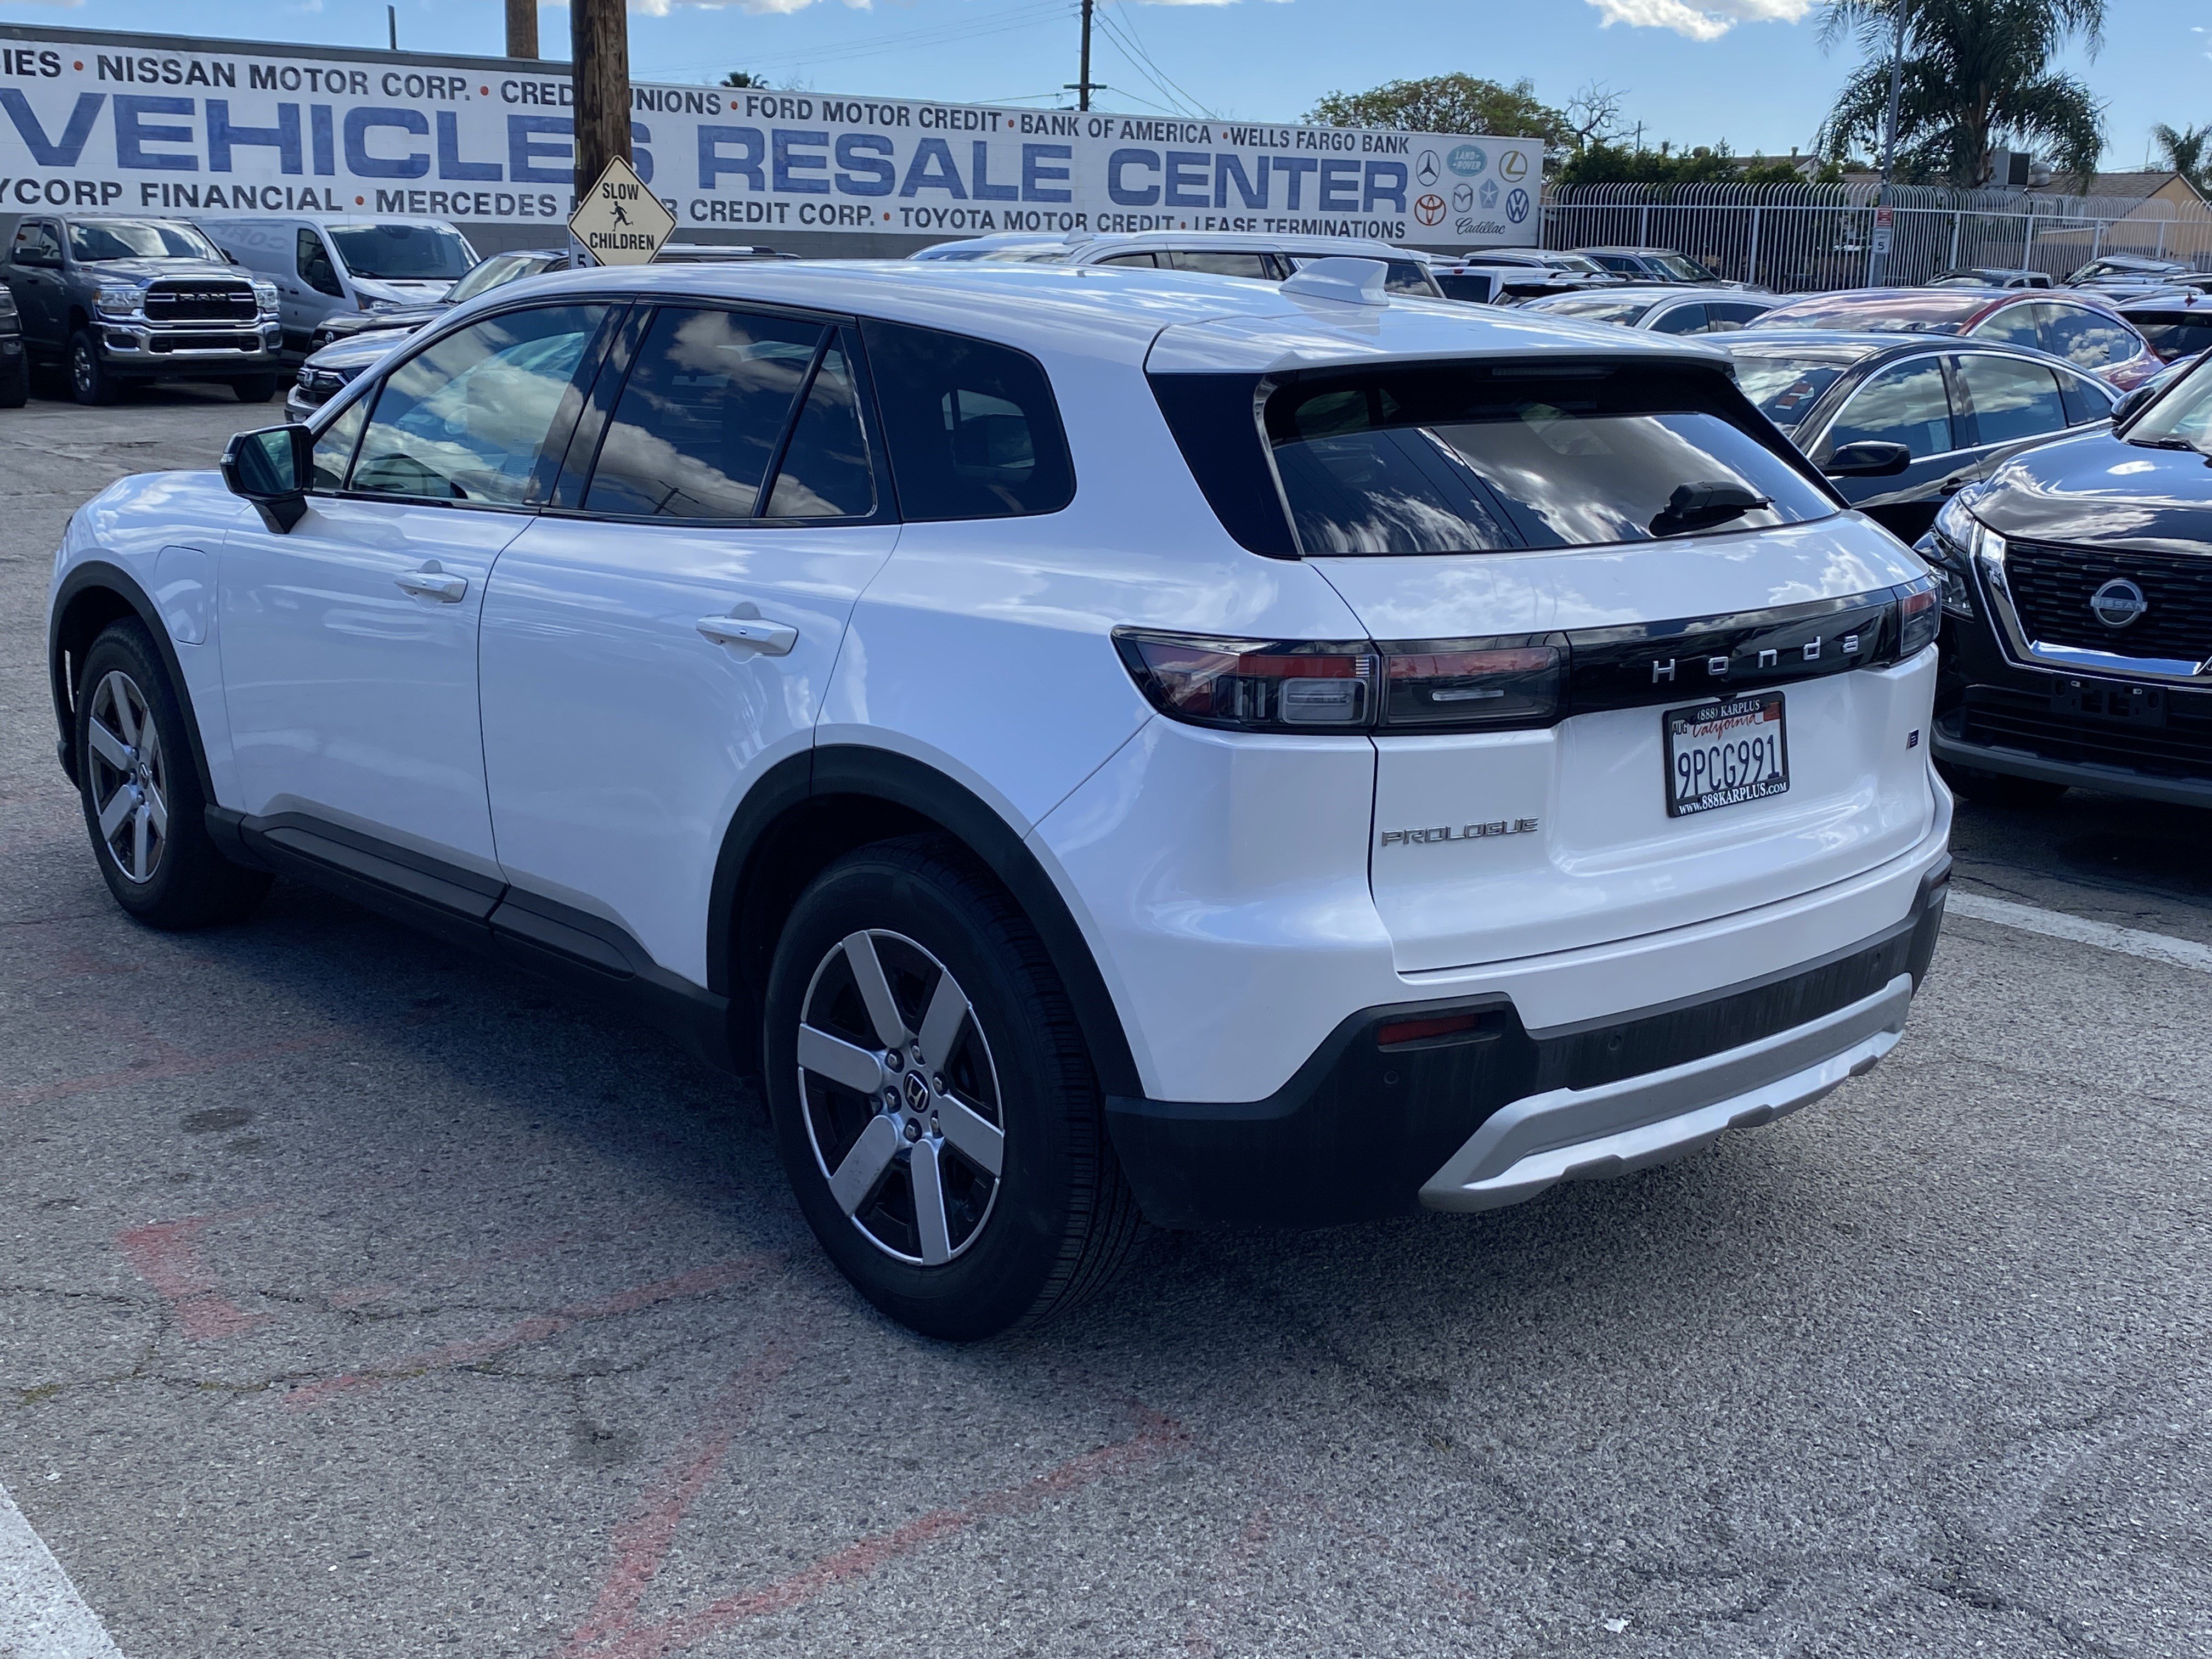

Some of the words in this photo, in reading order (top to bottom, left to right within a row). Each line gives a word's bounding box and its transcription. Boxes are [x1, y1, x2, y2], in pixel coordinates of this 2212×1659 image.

[0, 48, 61, 77] IES
[97, 54, 236, 88] NISSAN
[250, 64, 368, 95] MOTOR
[382, 72, 470, 101] CORP.
[500, 80, 574, 106] CRED
[629, 88, 721, 115] NIONS
[747, 96, 812, 120] FORD
[823, 101, 910, 127] MOTOR
[919, 106, 1002, 132] CREDIT
[1021, 114, 1080, 137] BANK
[1088, 117, 1114, 138] OF
[1120, 120, 1211, 144] AMERICA
[1231, 127, 1290, 148] WELLS
[1296, 131, 1355, 151] FARGO
[1362, 135, 1409, 154] BANK
[697, 124, 1072, 203] RESALE
[1108, 148, 1408, 213] CENTER
[602, 183, 639, 200] SLOW
[141, 182, 343, 211] FINANCIAL
[376, 189, 556, 216] MERCEDES
[690, 199, 790, 224] CREDIT
[799, 202, 874, 226] CORP.
[900, 207, 994, 229] TOYOTA
[1005, 211, 1088, 232] MOTOR
[1097, 213, 1174, 233] CREDIT
[1263, 219, 1406, 239] TERMINATIONS
[1455, 217, 1505, 235] Cadillac
[590, 232, 654, 250] CHILDREN
[1877, 241, 1884, 250] 5
[1697, 708, 1718, 720] (888)
[1720, 699, 1760, 717] KARPLUS
[1678, 734, 1780, 798] 9PCG991
[1382, 816, 1538, 847] PROLOGUE
